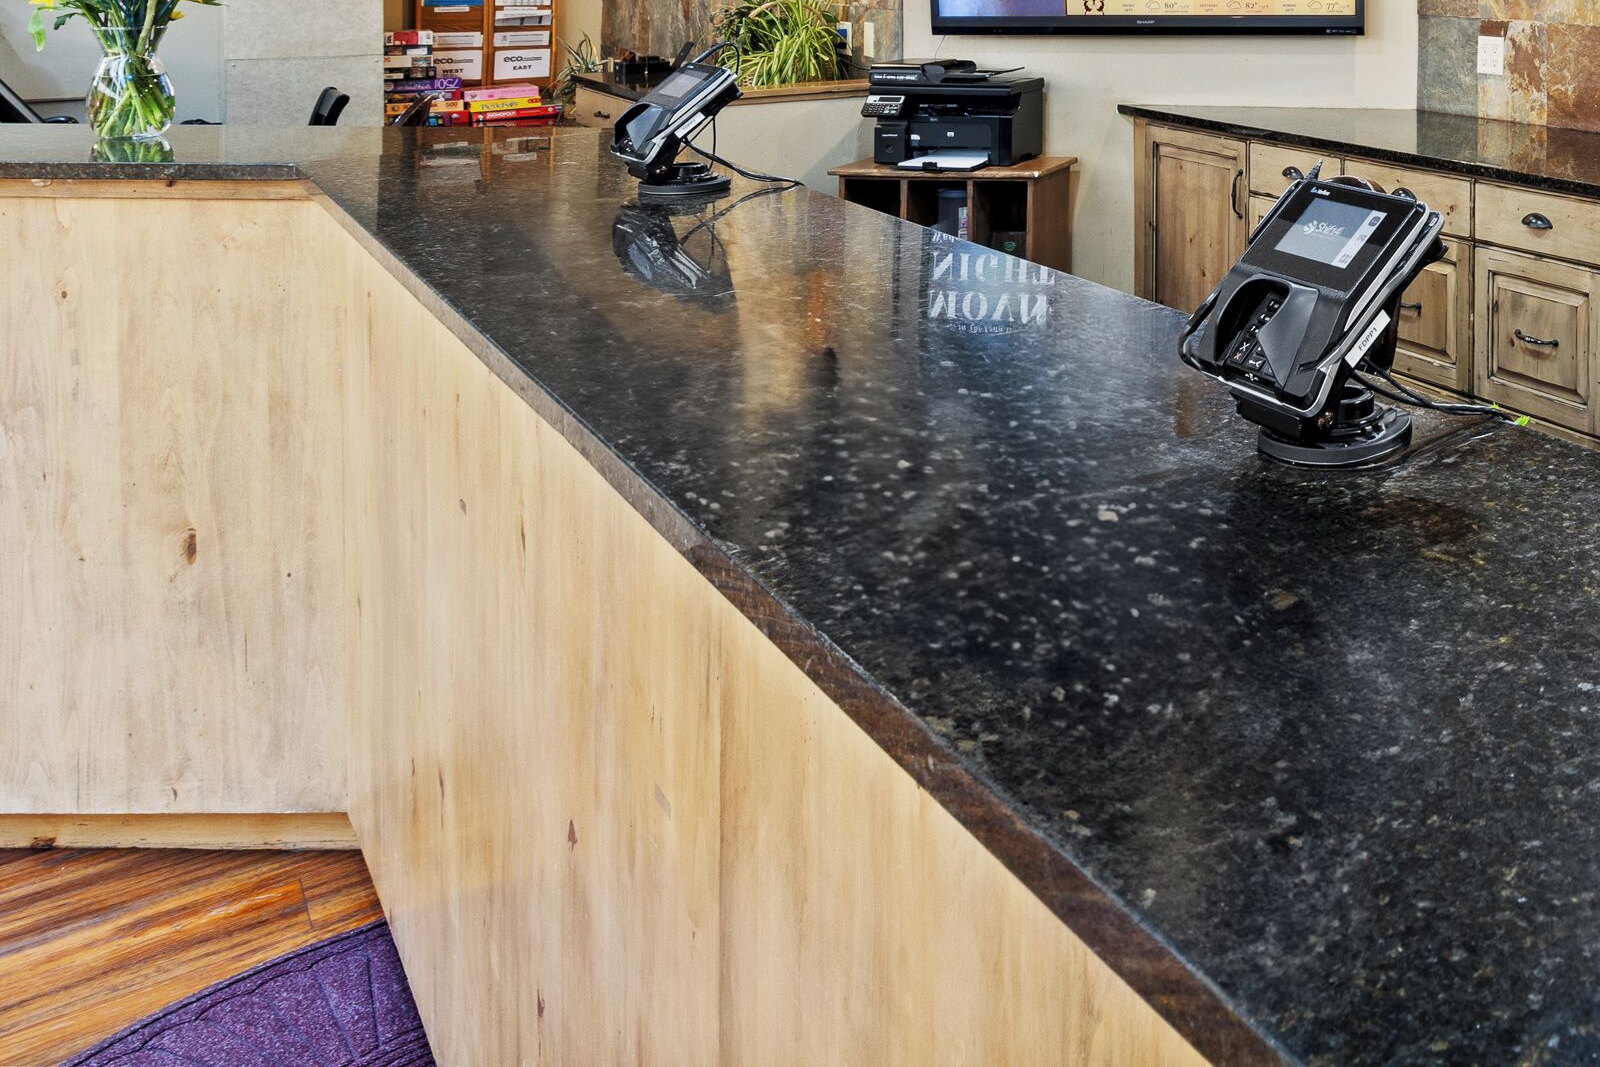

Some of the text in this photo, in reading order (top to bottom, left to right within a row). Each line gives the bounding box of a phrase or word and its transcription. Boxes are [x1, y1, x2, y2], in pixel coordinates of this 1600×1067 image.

[433, 57, 454, 65] eco
[504, 55, 523, 63] eco
[1358, 325, 1378, 353] FDPP1
